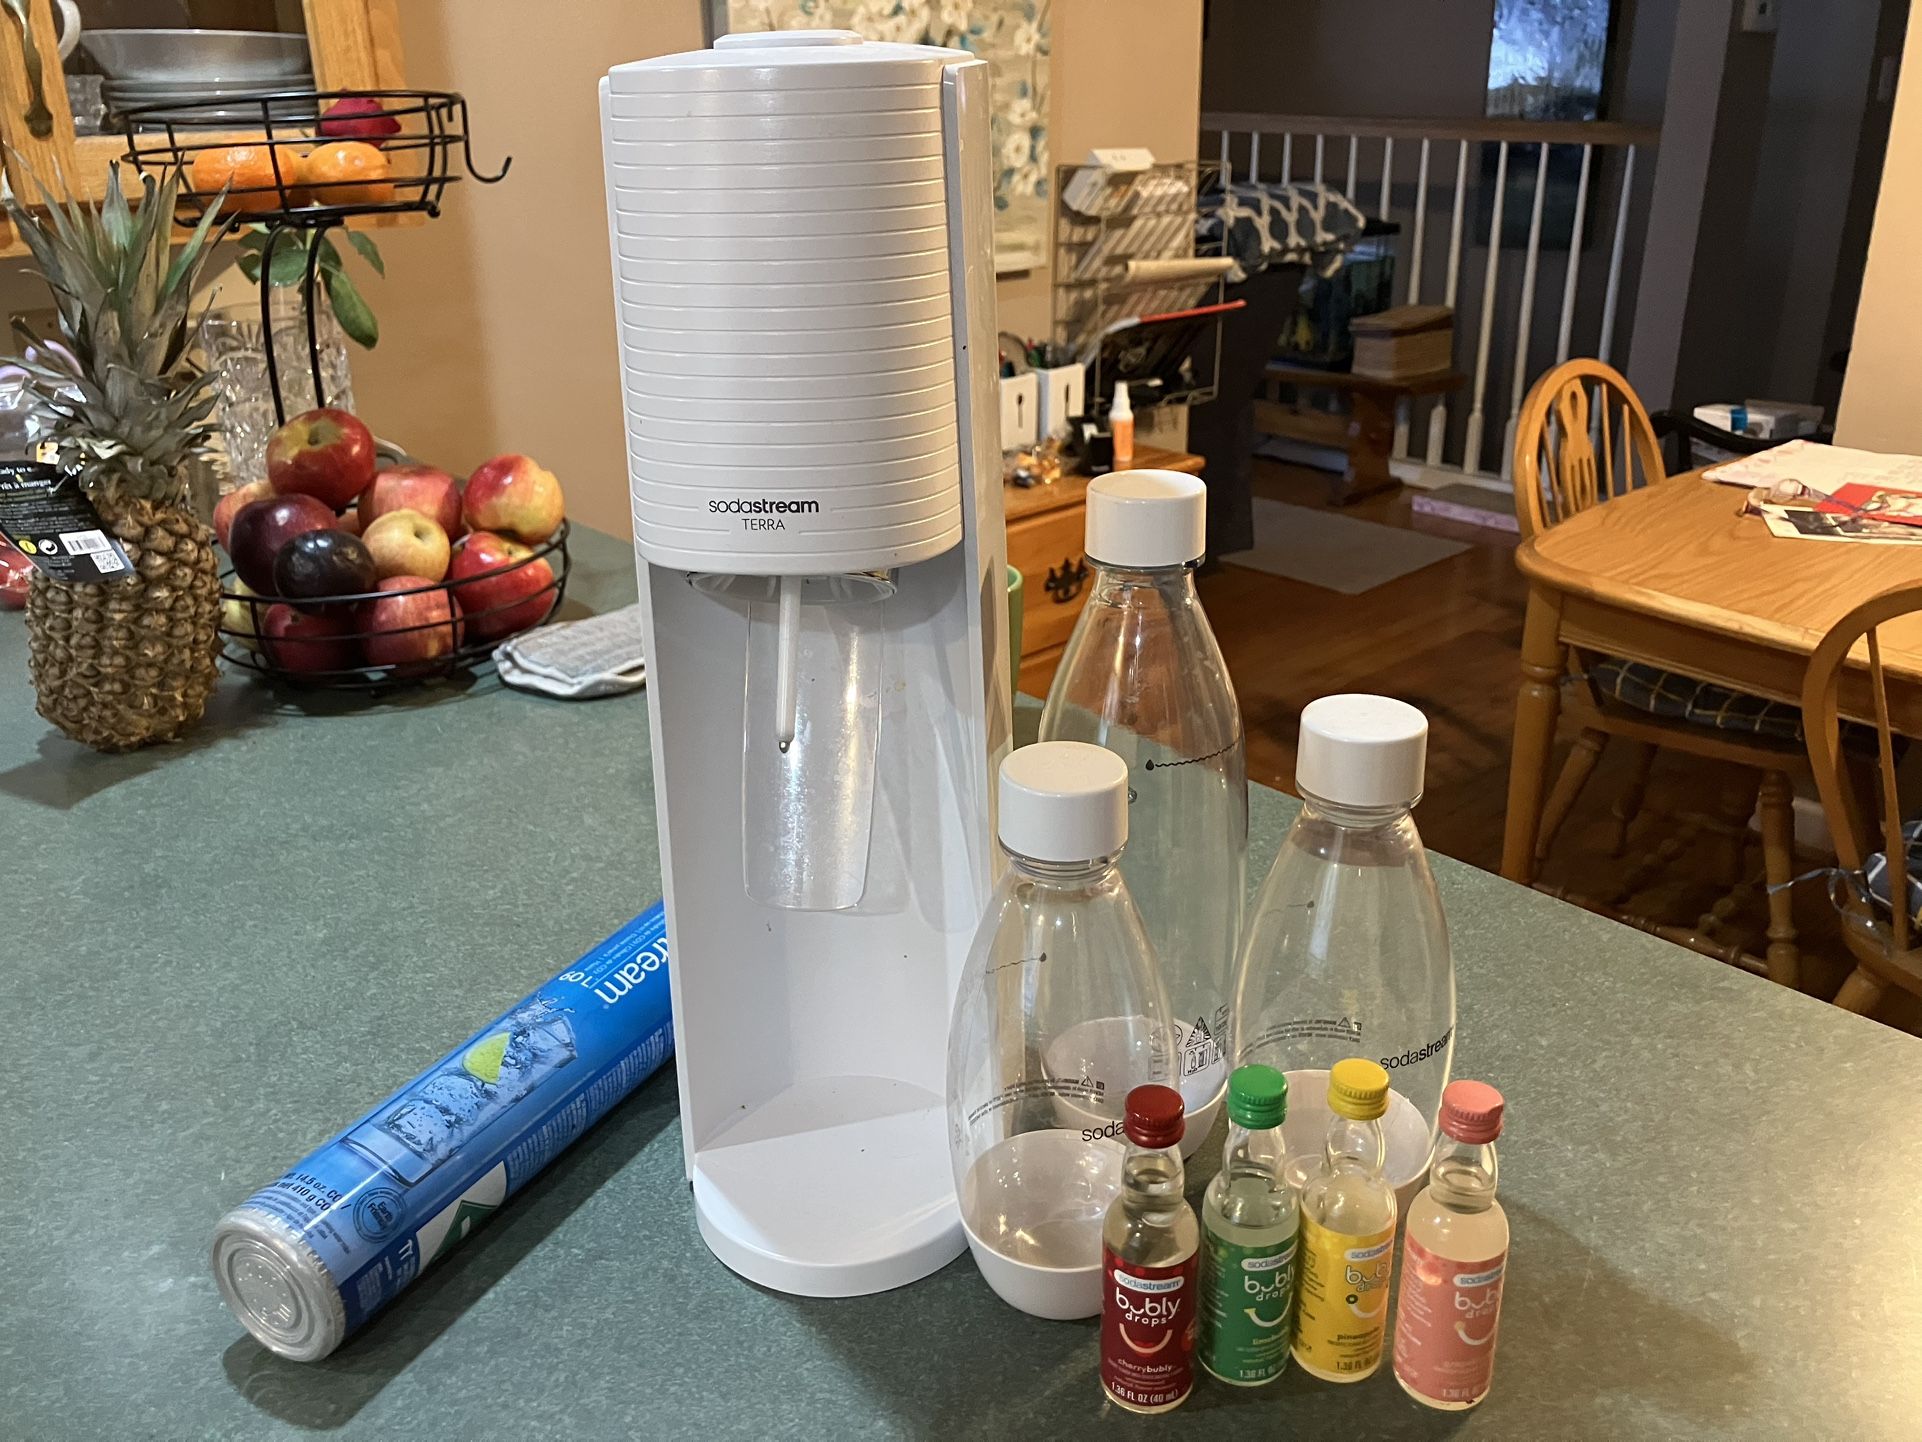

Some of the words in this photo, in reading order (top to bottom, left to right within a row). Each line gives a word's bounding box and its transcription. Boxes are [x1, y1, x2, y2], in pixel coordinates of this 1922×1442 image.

[708, 498, 819, 514] sodastream
[741, 518, 785, 530] TERRA
[292, 1182, 309, 1198] 410
[305, 1193, 316, 1203] g
[1119, 1274, 1180, 1291] sodastream
[1115, 1286, 1181, 1319] bubly
[1124, 1311, 1168, 1328] drops
[1127, 1390, 1135, 1401] FL
[1137, 1393, 1148, 1404] OZ
[1150, 1393, 1164, 1404] (40
